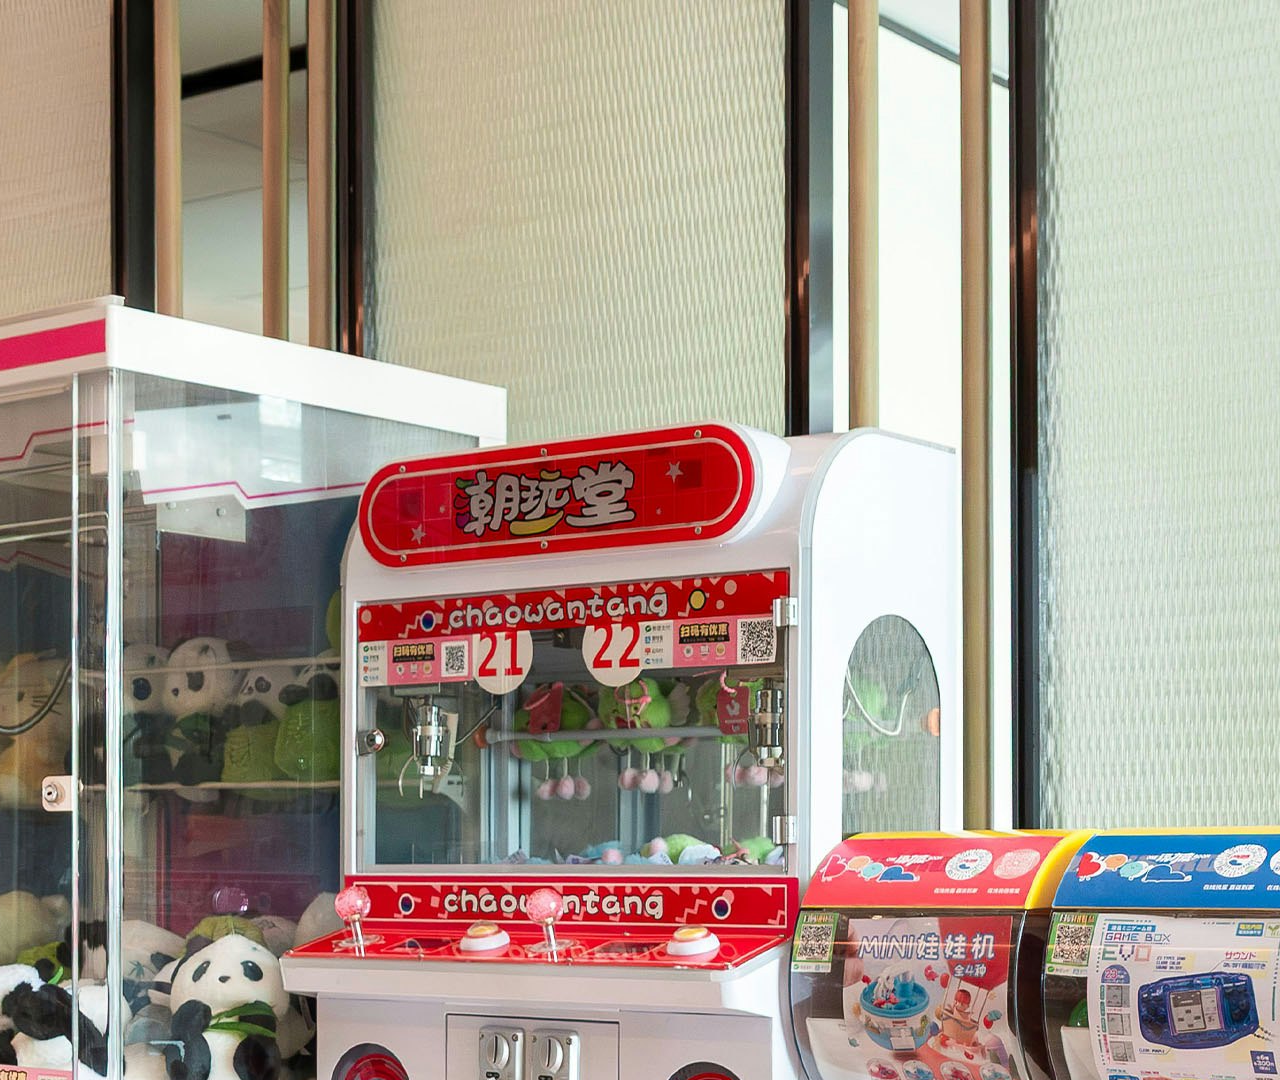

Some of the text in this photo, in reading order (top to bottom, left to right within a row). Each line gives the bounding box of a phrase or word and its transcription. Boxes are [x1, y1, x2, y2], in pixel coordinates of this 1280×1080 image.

[449, 591, 668, 629] chaowantang
[680, 623, 728, 637] 扫码有优惠
[392, 642, 435, 657] 扫码有优惠
[592, 622, 640, 669] 22
[478, 632, 523, 677] 21
[443, 888, 663, 919] chaontang
[1105, 932, 1171, 943] GAME BOX
[1225, 951, 1257, 960] サウンド
[1105, 969, 1118, 979] 23
